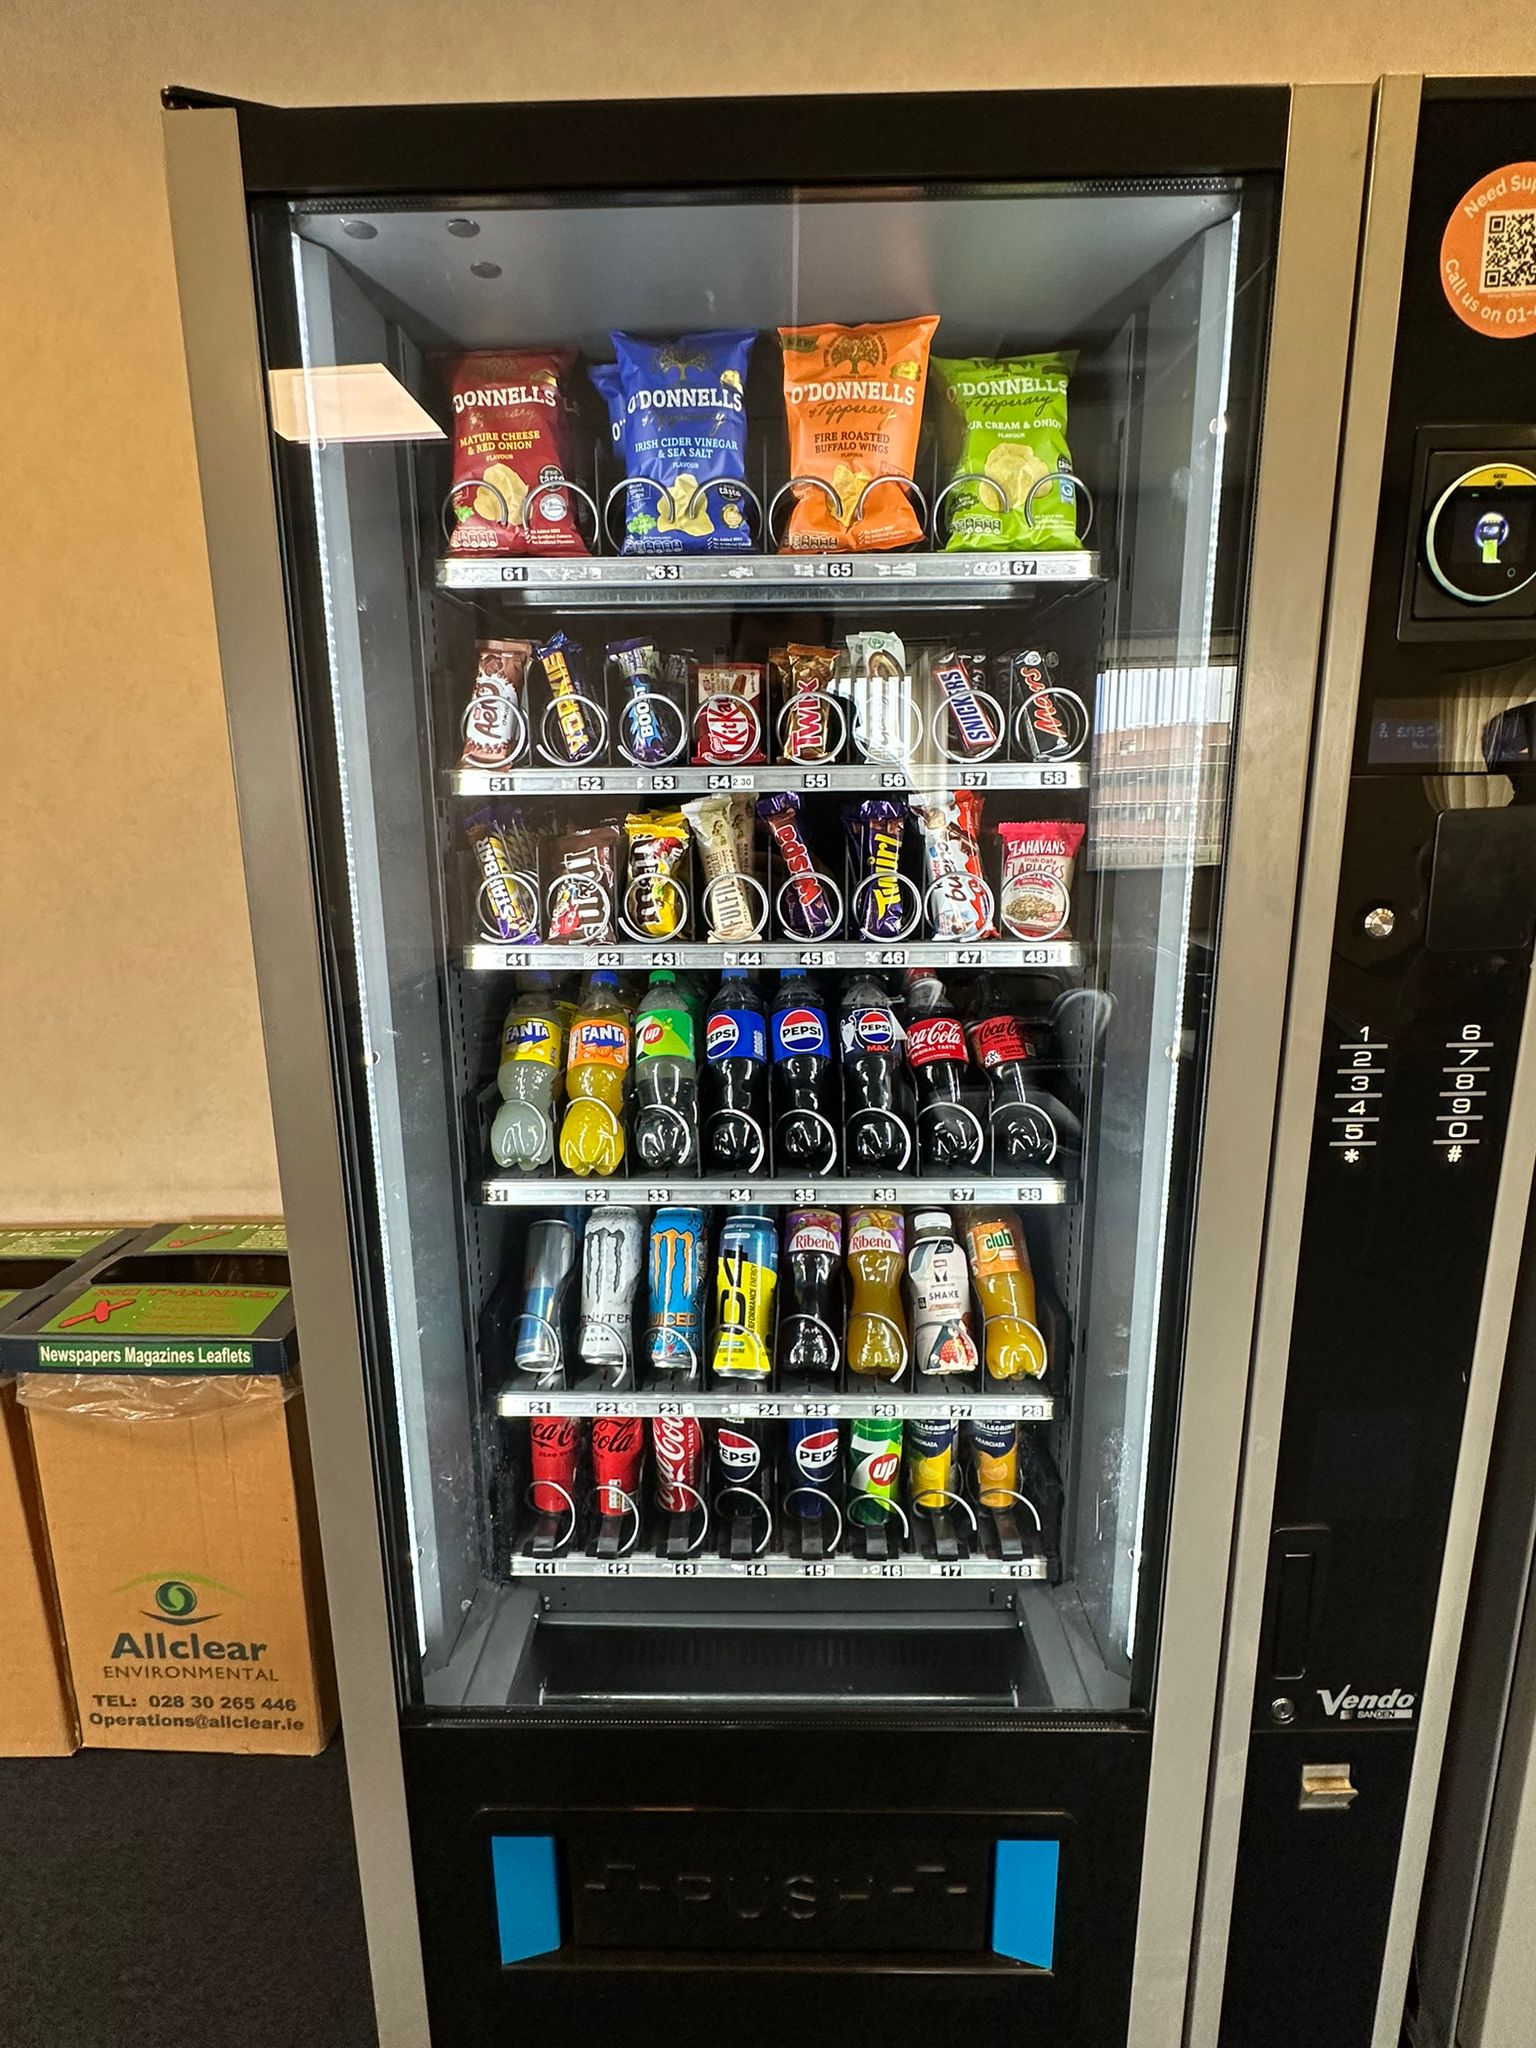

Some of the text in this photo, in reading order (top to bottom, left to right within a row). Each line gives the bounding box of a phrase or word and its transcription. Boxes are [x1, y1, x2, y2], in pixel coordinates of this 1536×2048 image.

[1464, 178, 1508, 219] Need
[1445, 259, 1468, 296] Call
[1462, 295, 1480, 313] us
[1480, 306, 1501, 323] on
[791, 381, 915, 406] O'DONNELLS
[627, 388, 743, 414] O'DONNELLS
[985, 421, 1020, 430] CREAM
[1023, 421, 1030, 429] &
[460, 430, 540, 448] MATURE CHEESE
[815, 431, 890, 443] FIRE ROASTED
[467, 440, 533, 456] & RED ONION
[635, 436, 738, 452] IRISH CIDER VINEGAR
[815, 442, 889, 454] BUFFALO WINGS
[485, 453, 514, 461] FLAVOUR
[658, 448, 713, 459] & SEA SALT
[503, 568, 524, 580] 61
[654, 567, 678, 579] 63
[830, 565, 851, 576] 65
[1013, 562, 1035, 574] 67
[580, 778, 601, 790] 52
[654, 777, 675, 789] 53
[709, 777, 729, 789] 54
[805, 775, 827, 787] 55
[883, 774, 905, 786] 56
[964, 773, 985, 785] 57
[1044, 772, 1065, 784] 58
[491, 779, 511, 790] 51
[869, 834, 902, 921] Twirl
[716, 879, 742, 930] FULFIL
[507, 954, 526, 965] 41
[601, 954, 620, 965] 42
[654, 953, 673, 965] 43
[740, 953, 760, 965] 44
[801, 952, 821, 964] 45
[883, 952, 904, 963] 46
[959, 951, 980, 963] 47
[1026, 951, 1046, 963] 48
[506, 1021, 550, 1042] FANTA
[581, 1024, 625, 1044] FANTA
[782, 1027, 821, 1038] PEPSI
[860, 1024, 891, 1033] PEPSI
[1360, 1026, 1370, 1042] 1
[1462, 1024, 1481, 1040] 6
[912, 1047, 936, 1059] ORIGINAL
[1353, 1051, 1372, 1066] 2
[1459, 1049, 1479, 1065] 7
[1351, 1076, 1369, 1091] 3
[1455, 1074, 1474, 1089] 8
[1348, 1100, 1366, 1115] 4
[1452, 1098, 1471, 1113] 9
[1345, 1124, 1364, 1139] 5
[1448, 1122, 1467, 1137] 0
[487, 1190, 504, 1201] 31
[587, 1190, 606, 1201] 32
[649, 1190, 669, 1201] 33
[731, 1190, 750, 1200] 34
[795, 1190, 815, 1200] 35
[875, 1190, 895, 1200] 36
[954, 1189, 974, 1200] 37
[1021, 1189, 1041, 1200] 38
[796, 1236, 834, 1250] Ribena
[852, 1235, 891, 1250] Ribena
[986, 1230, 1013, 1249] club
[929, 1291, 959, 1300] SHAKE
[40, 1346, 251, 1367] Newspapers Magazines Leaflets
[530, 1403, 547, 1413] 21
[598, 1403, 615, 1413] 22
[660, 1404, 679, 1414] 23
[760, 1405, 779, 1415] 24
[807, 1405, 826, 1415] 25
[875, 1405, 894, 1415] 26
[952, 1405, 971, 1416] 27
[1023, 1405, 1041, 1416] 28
[719, 1447, 757, 1462] EPSI
[536, 1564, 552, 1574] 11
[610, 1564, 628, 1574] 12
[676, 1564, 694, 1575] 13
[748, 1565, 766, 1576] 14
[807, 1566, 825, 1576] 15
[884, 1566, 901, 1576] 16
[943, 1566, 960, 1576] 17
[1012, 1566, 1030, 1576] 18
[111, 1632, 267, 1661] Allclear
[103, 1666, 279, 1682] ENVIRONMENTAL
[93, 1695, 297, 1712] TEL: 028 30 265 446
[1316, 1684, 1415, 1715] Vendo
[1357, 1710, 1396, 1719] SANDEN
[89, 1712, 304, 1731] Operations@allclear.ie
